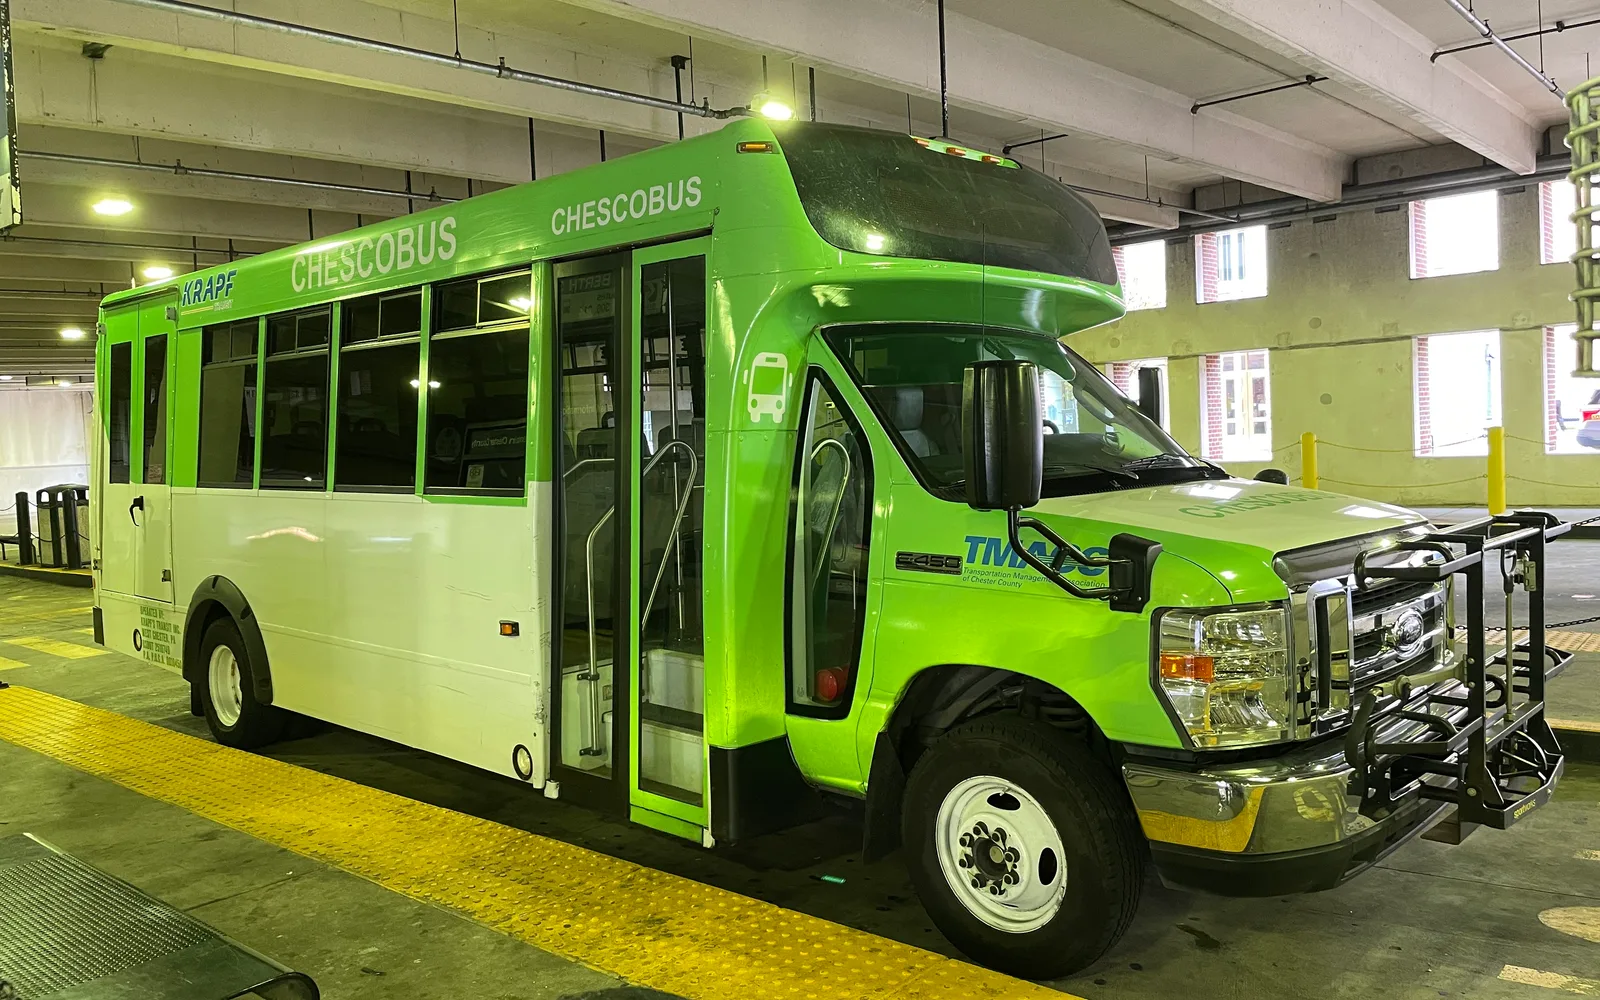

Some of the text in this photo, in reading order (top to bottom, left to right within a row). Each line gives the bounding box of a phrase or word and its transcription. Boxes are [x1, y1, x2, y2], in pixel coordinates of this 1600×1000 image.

[551, 176, 702, 236] CHESCOBUS
[291, 216, 457, 293] CHESCOBUS
[181, 268, 239, 308] KRAPF
[963, 566, 1012, 578] Transportation
[970, 575, 996, 585] Chester
[997, 578, 1023, 589] County
